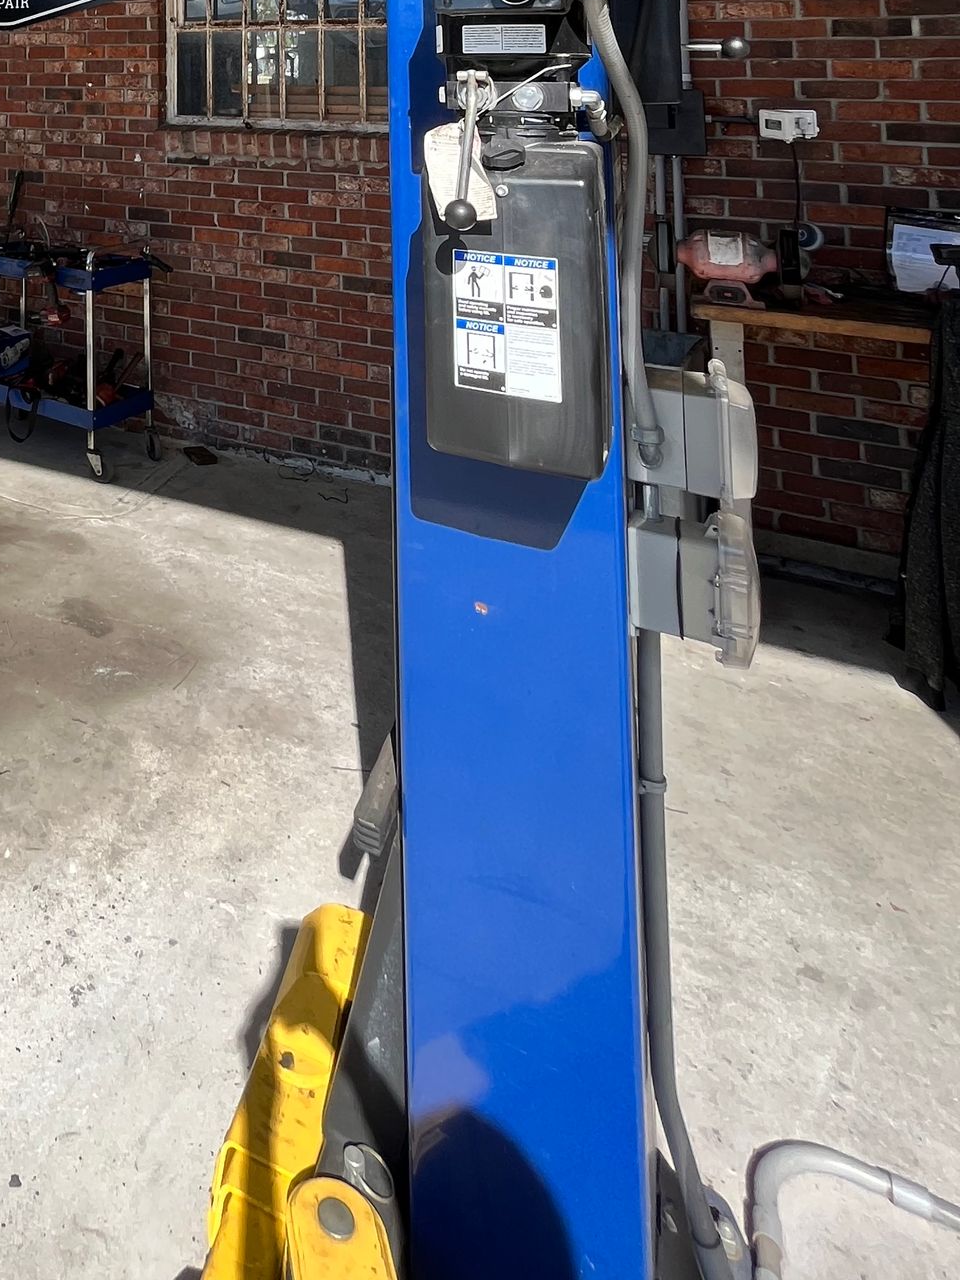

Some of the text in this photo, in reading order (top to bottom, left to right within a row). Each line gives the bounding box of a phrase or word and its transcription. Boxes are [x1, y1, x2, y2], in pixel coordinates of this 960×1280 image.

[463, 252, 496, 264] NOTICE
[514, 258, 549, 269] NOTICE
[465, 321, 499, 333] NOTICE
